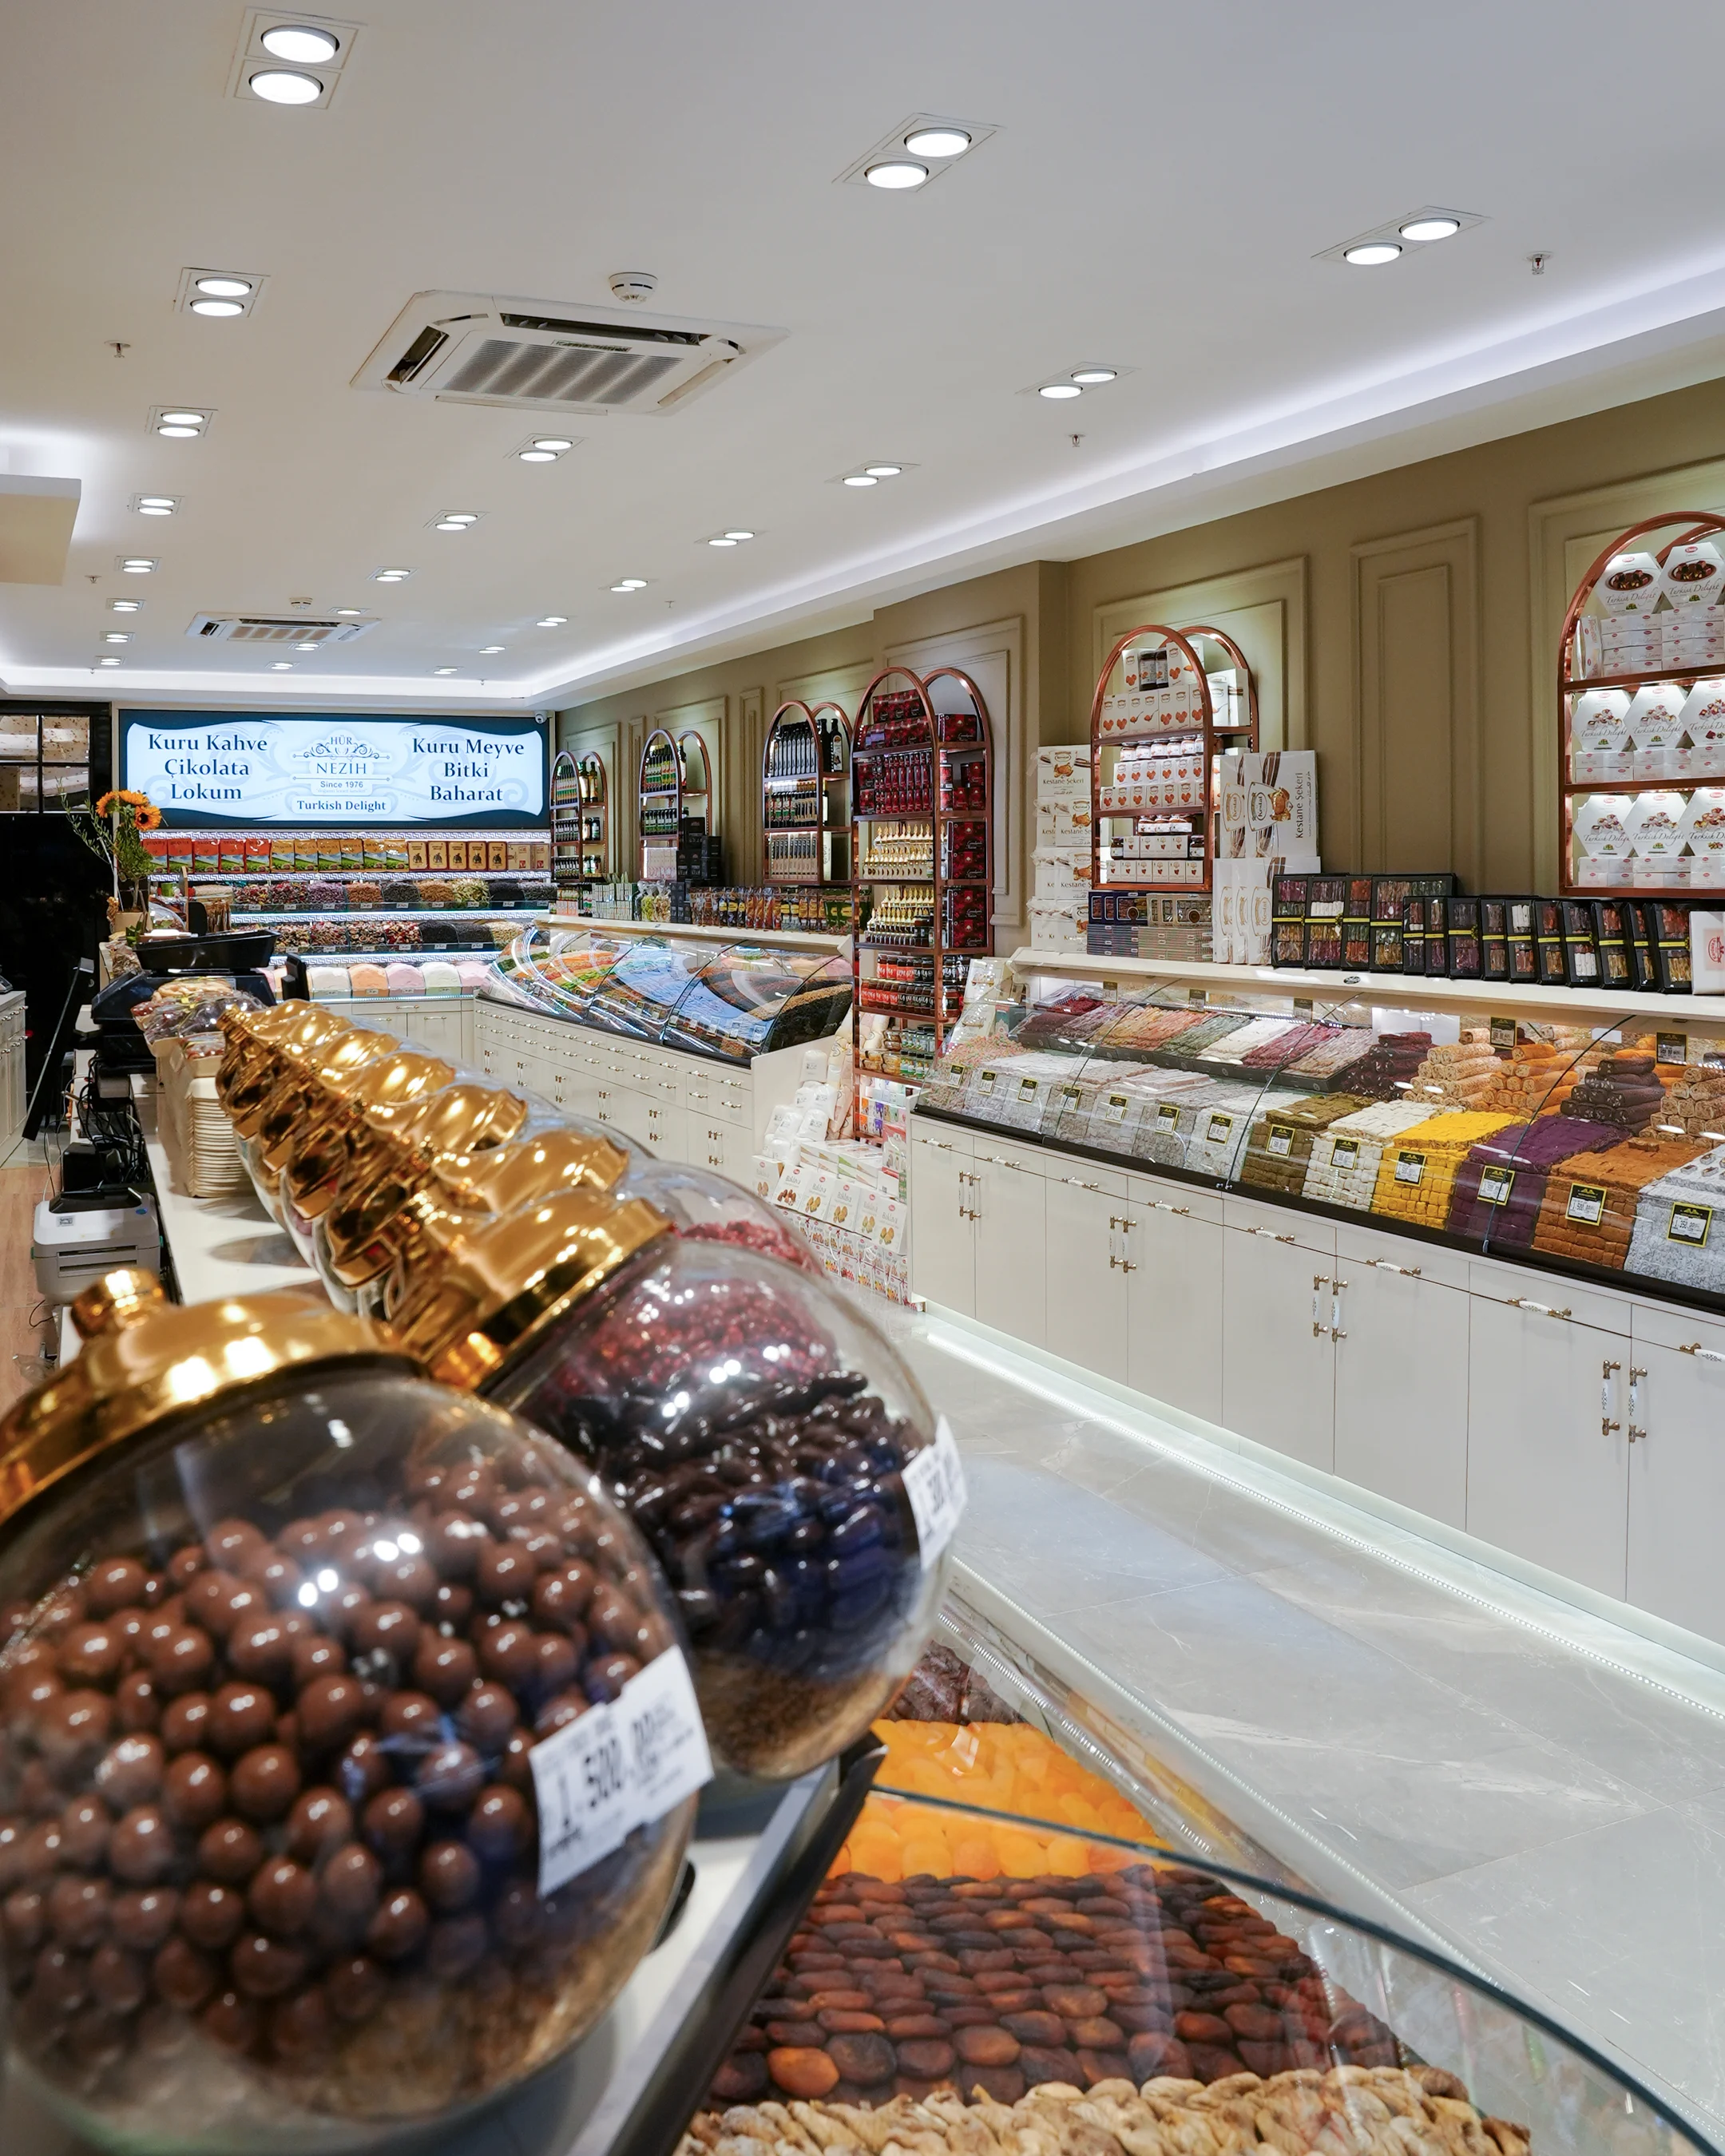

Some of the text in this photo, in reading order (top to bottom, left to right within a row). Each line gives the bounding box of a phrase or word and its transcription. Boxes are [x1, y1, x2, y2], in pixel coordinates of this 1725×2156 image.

[149, 734, 268, 751] Kuru Kahve
[331, 735, 352, 745] HÜR
[413, 738, 524, 759] Kuru Meyve
[165, 759, 249, 779] Çikolata
[444, 762, 489, 777] Bitki
[171, 783, 242, 799] Lokum
[430, 785, 503, 801] Baharat
[1295, 773, 1304, 800] Şekeri
[297, 800, 387, 813] Turkish Delight
